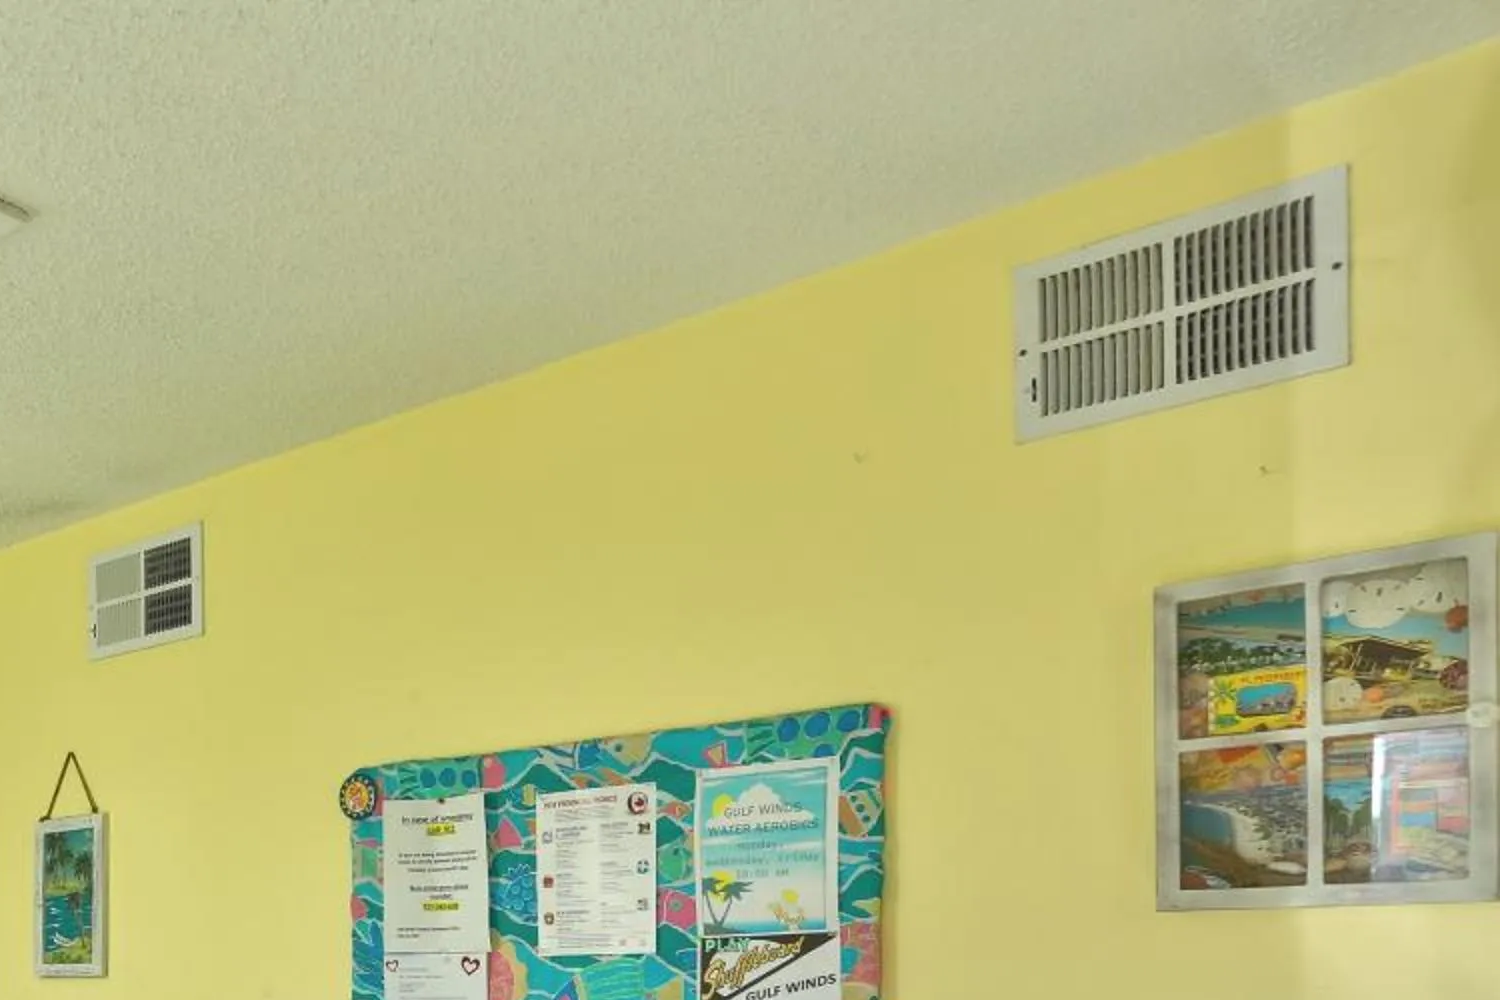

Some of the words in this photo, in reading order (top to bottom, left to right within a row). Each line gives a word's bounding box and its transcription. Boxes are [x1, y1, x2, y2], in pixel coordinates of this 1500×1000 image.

[723, 805, 755, 818] GULF
[759, 801, 803, 815] WINDS
[707, 823, 751, 836] WATER
[705, 937, 750, 953] PLAY
[785, 973, 837, 993] WINDS
